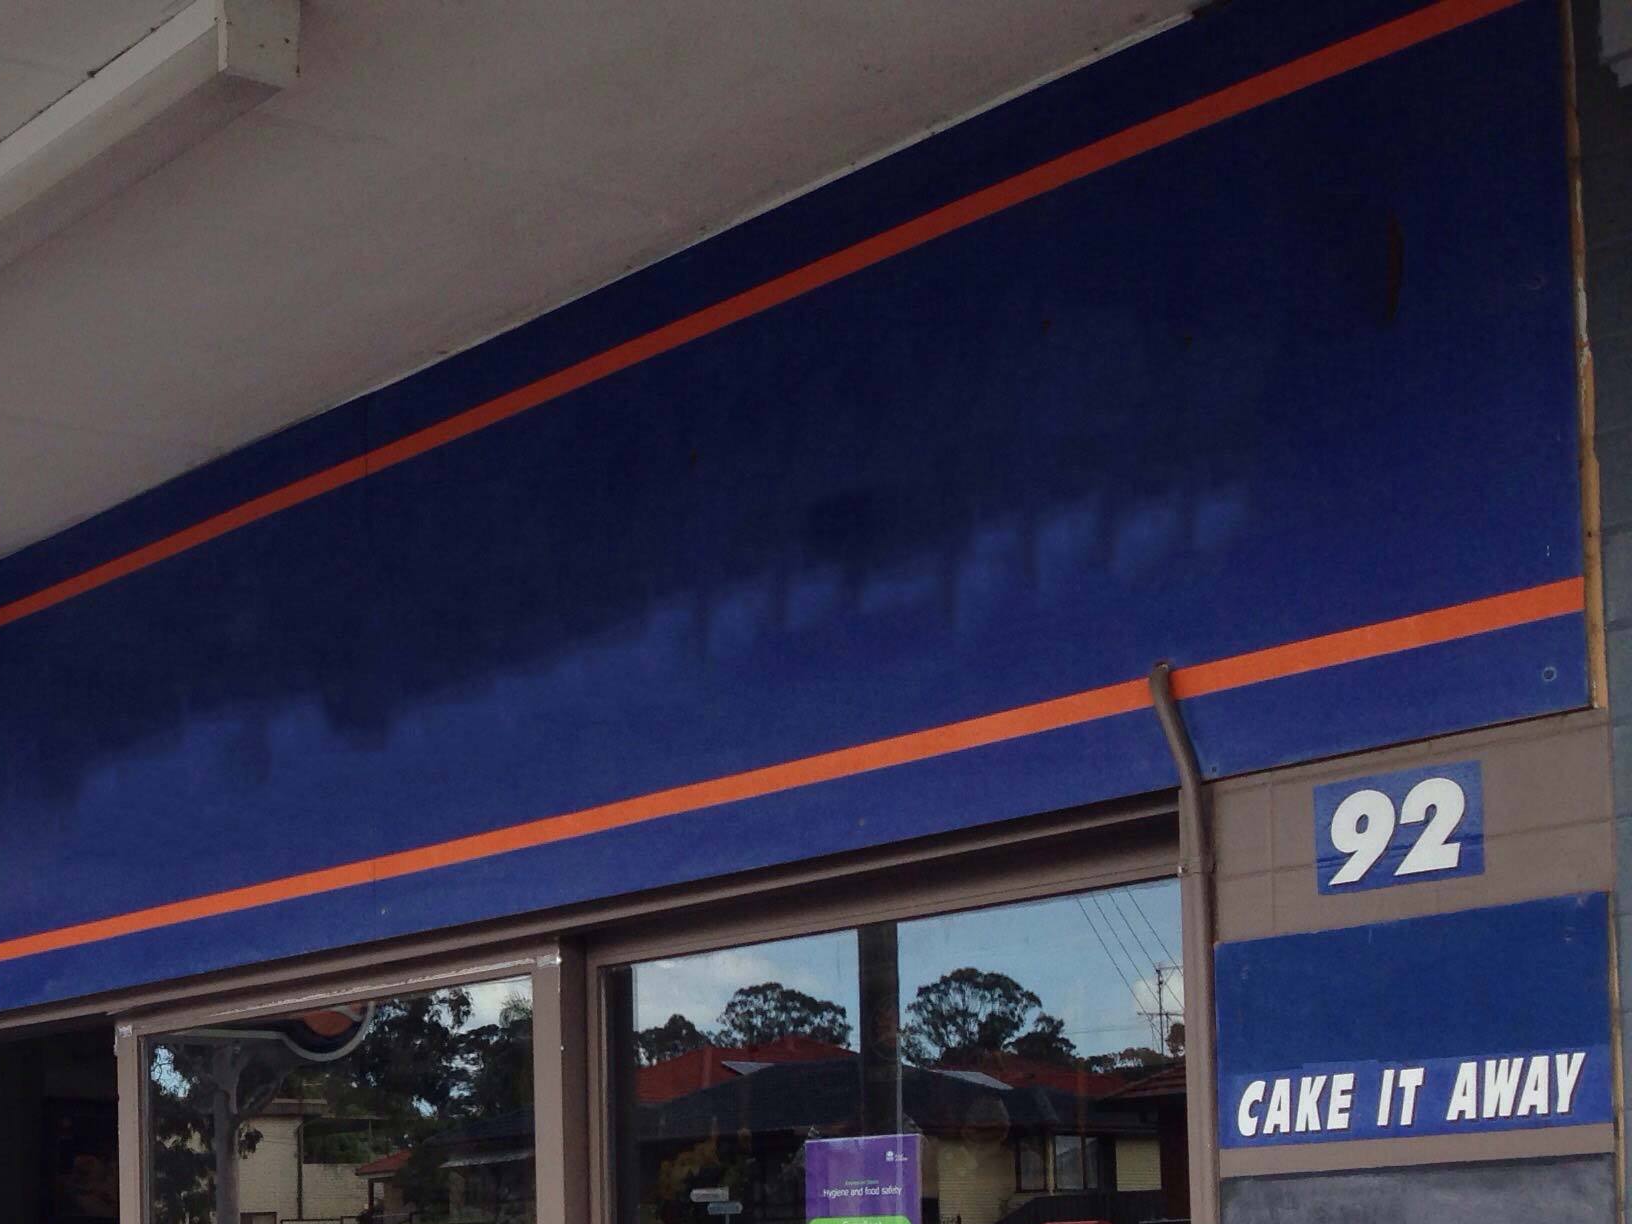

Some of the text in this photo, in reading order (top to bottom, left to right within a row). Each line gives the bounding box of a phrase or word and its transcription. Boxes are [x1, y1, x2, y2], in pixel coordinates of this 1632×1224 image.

[1327, 776, 1467, 887] 92
[1236, 1052, 1587, 1138] CAKE IT AWAY
[823, 1184, 903, 1199] Hygiene and food safety
